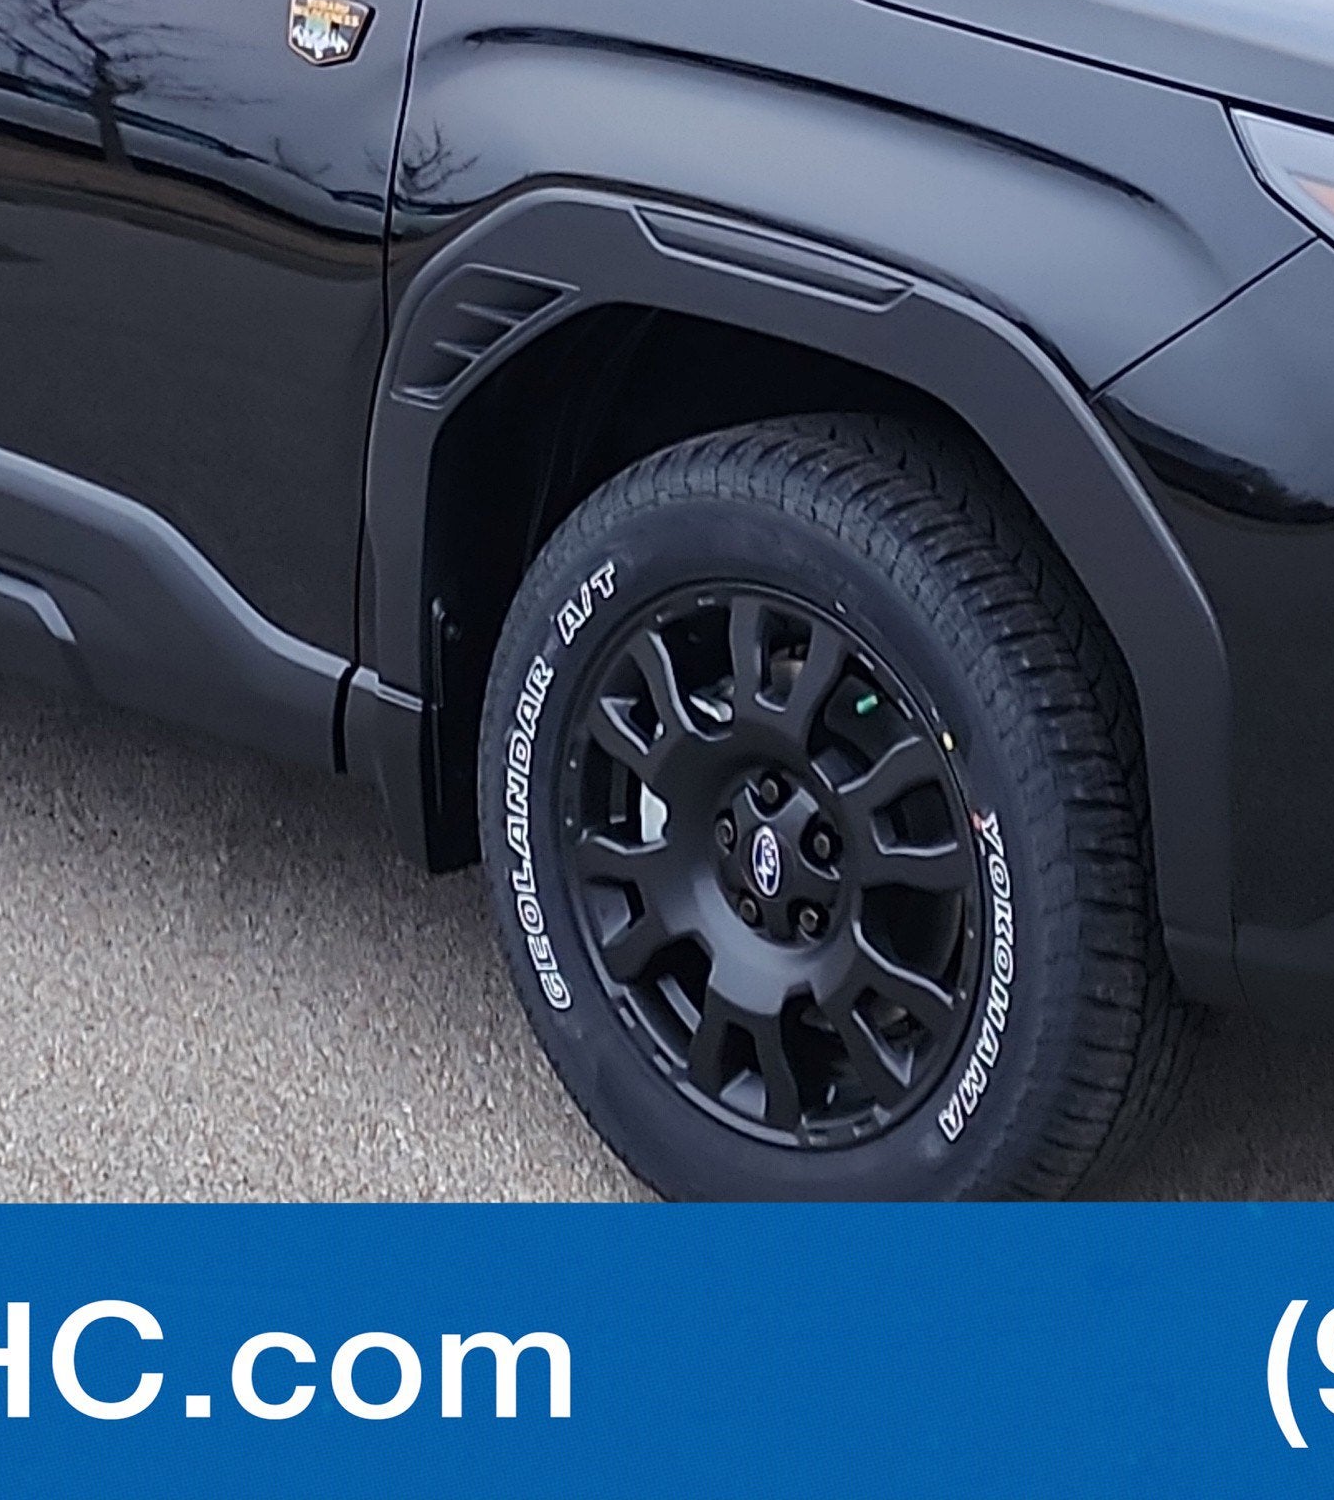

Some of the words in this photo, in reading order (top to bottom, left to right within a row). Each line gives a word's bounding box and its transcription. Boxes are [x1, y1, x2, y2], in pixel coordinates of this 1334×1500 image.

[505, 654, 571, 1010] GEOLANDAR
[556, 562, 616, 645] A/T
[938, 811, 1014, 1143] YOKOHAMA
